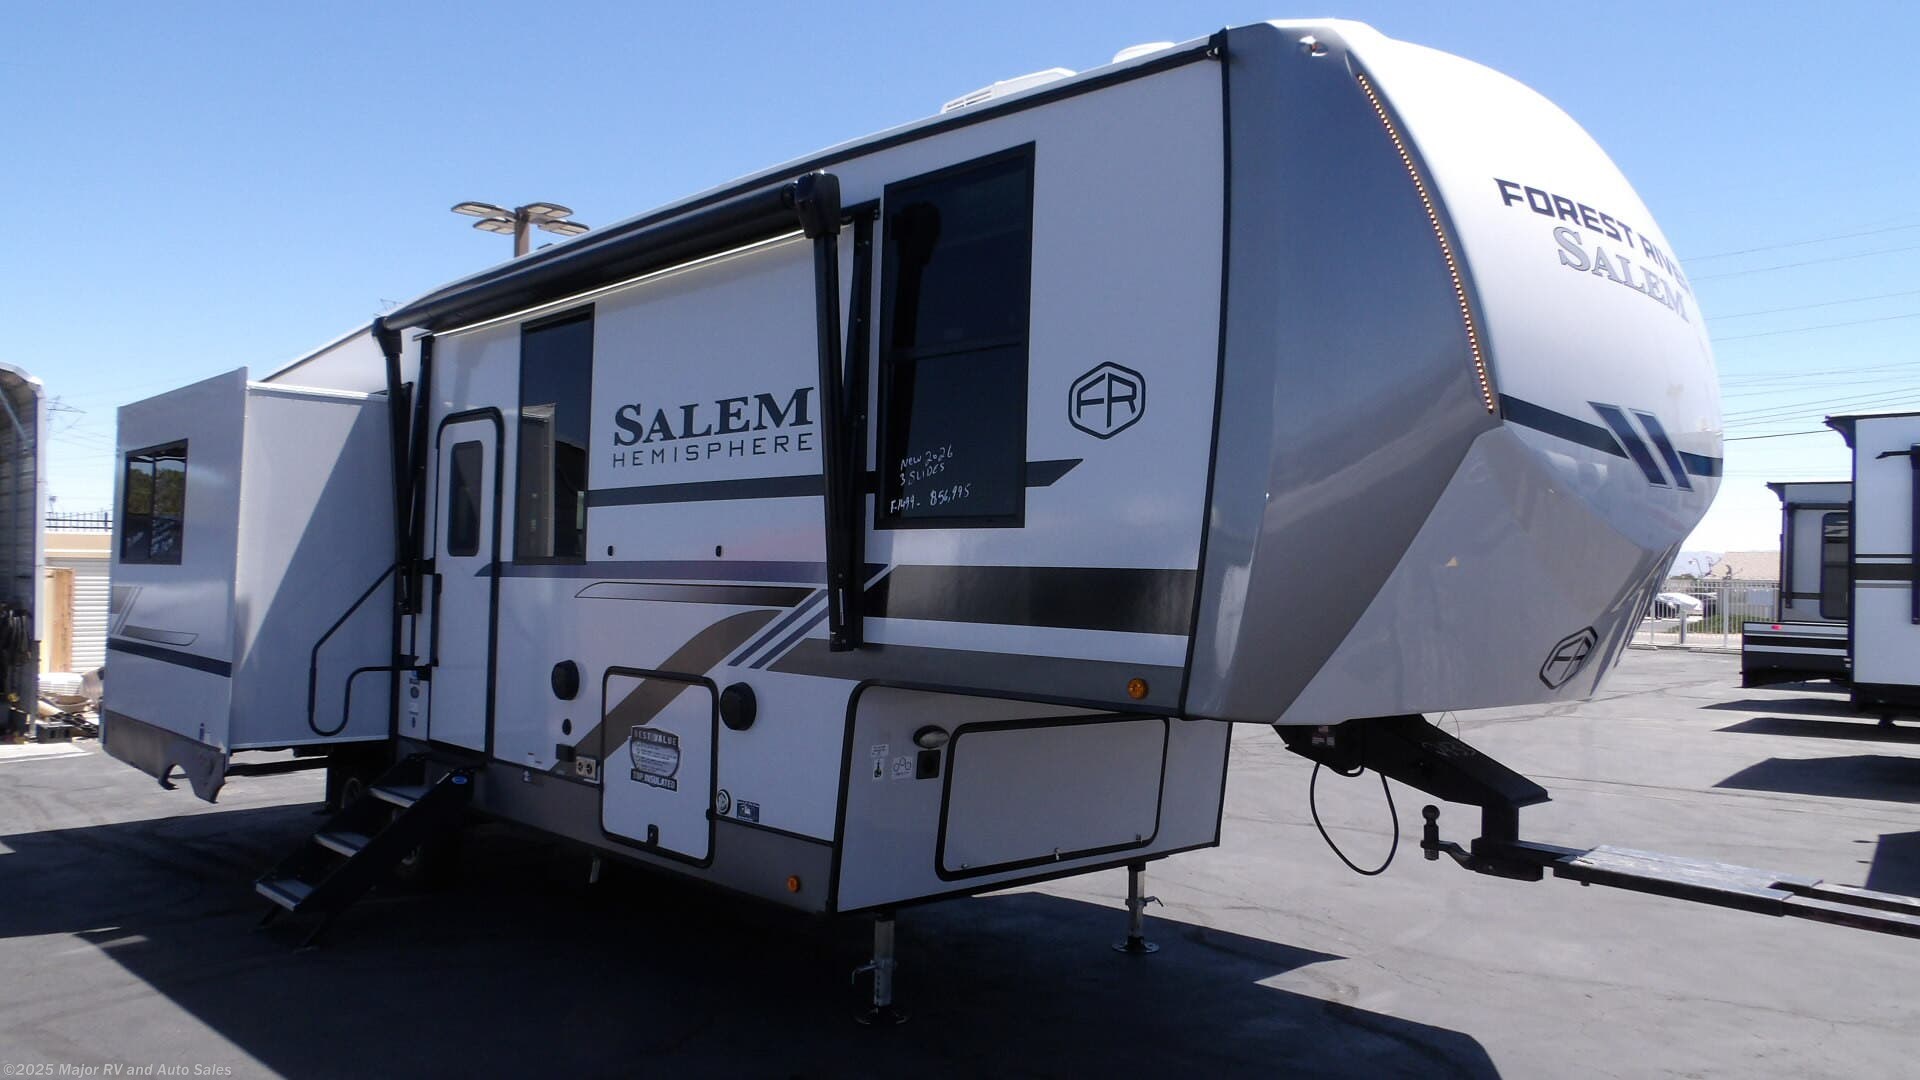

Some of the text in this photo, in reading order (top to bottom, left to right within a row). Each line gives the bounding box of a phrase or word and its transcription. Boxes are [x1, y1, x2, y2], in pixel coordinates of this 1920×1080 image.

[1494, 178, 1635, 249] FOREST
[1553, 226, 1690, 323] SALEM
[613, 386, 815, 446] SALEM
[612, 432, 814, 468] HEMISPHERE
